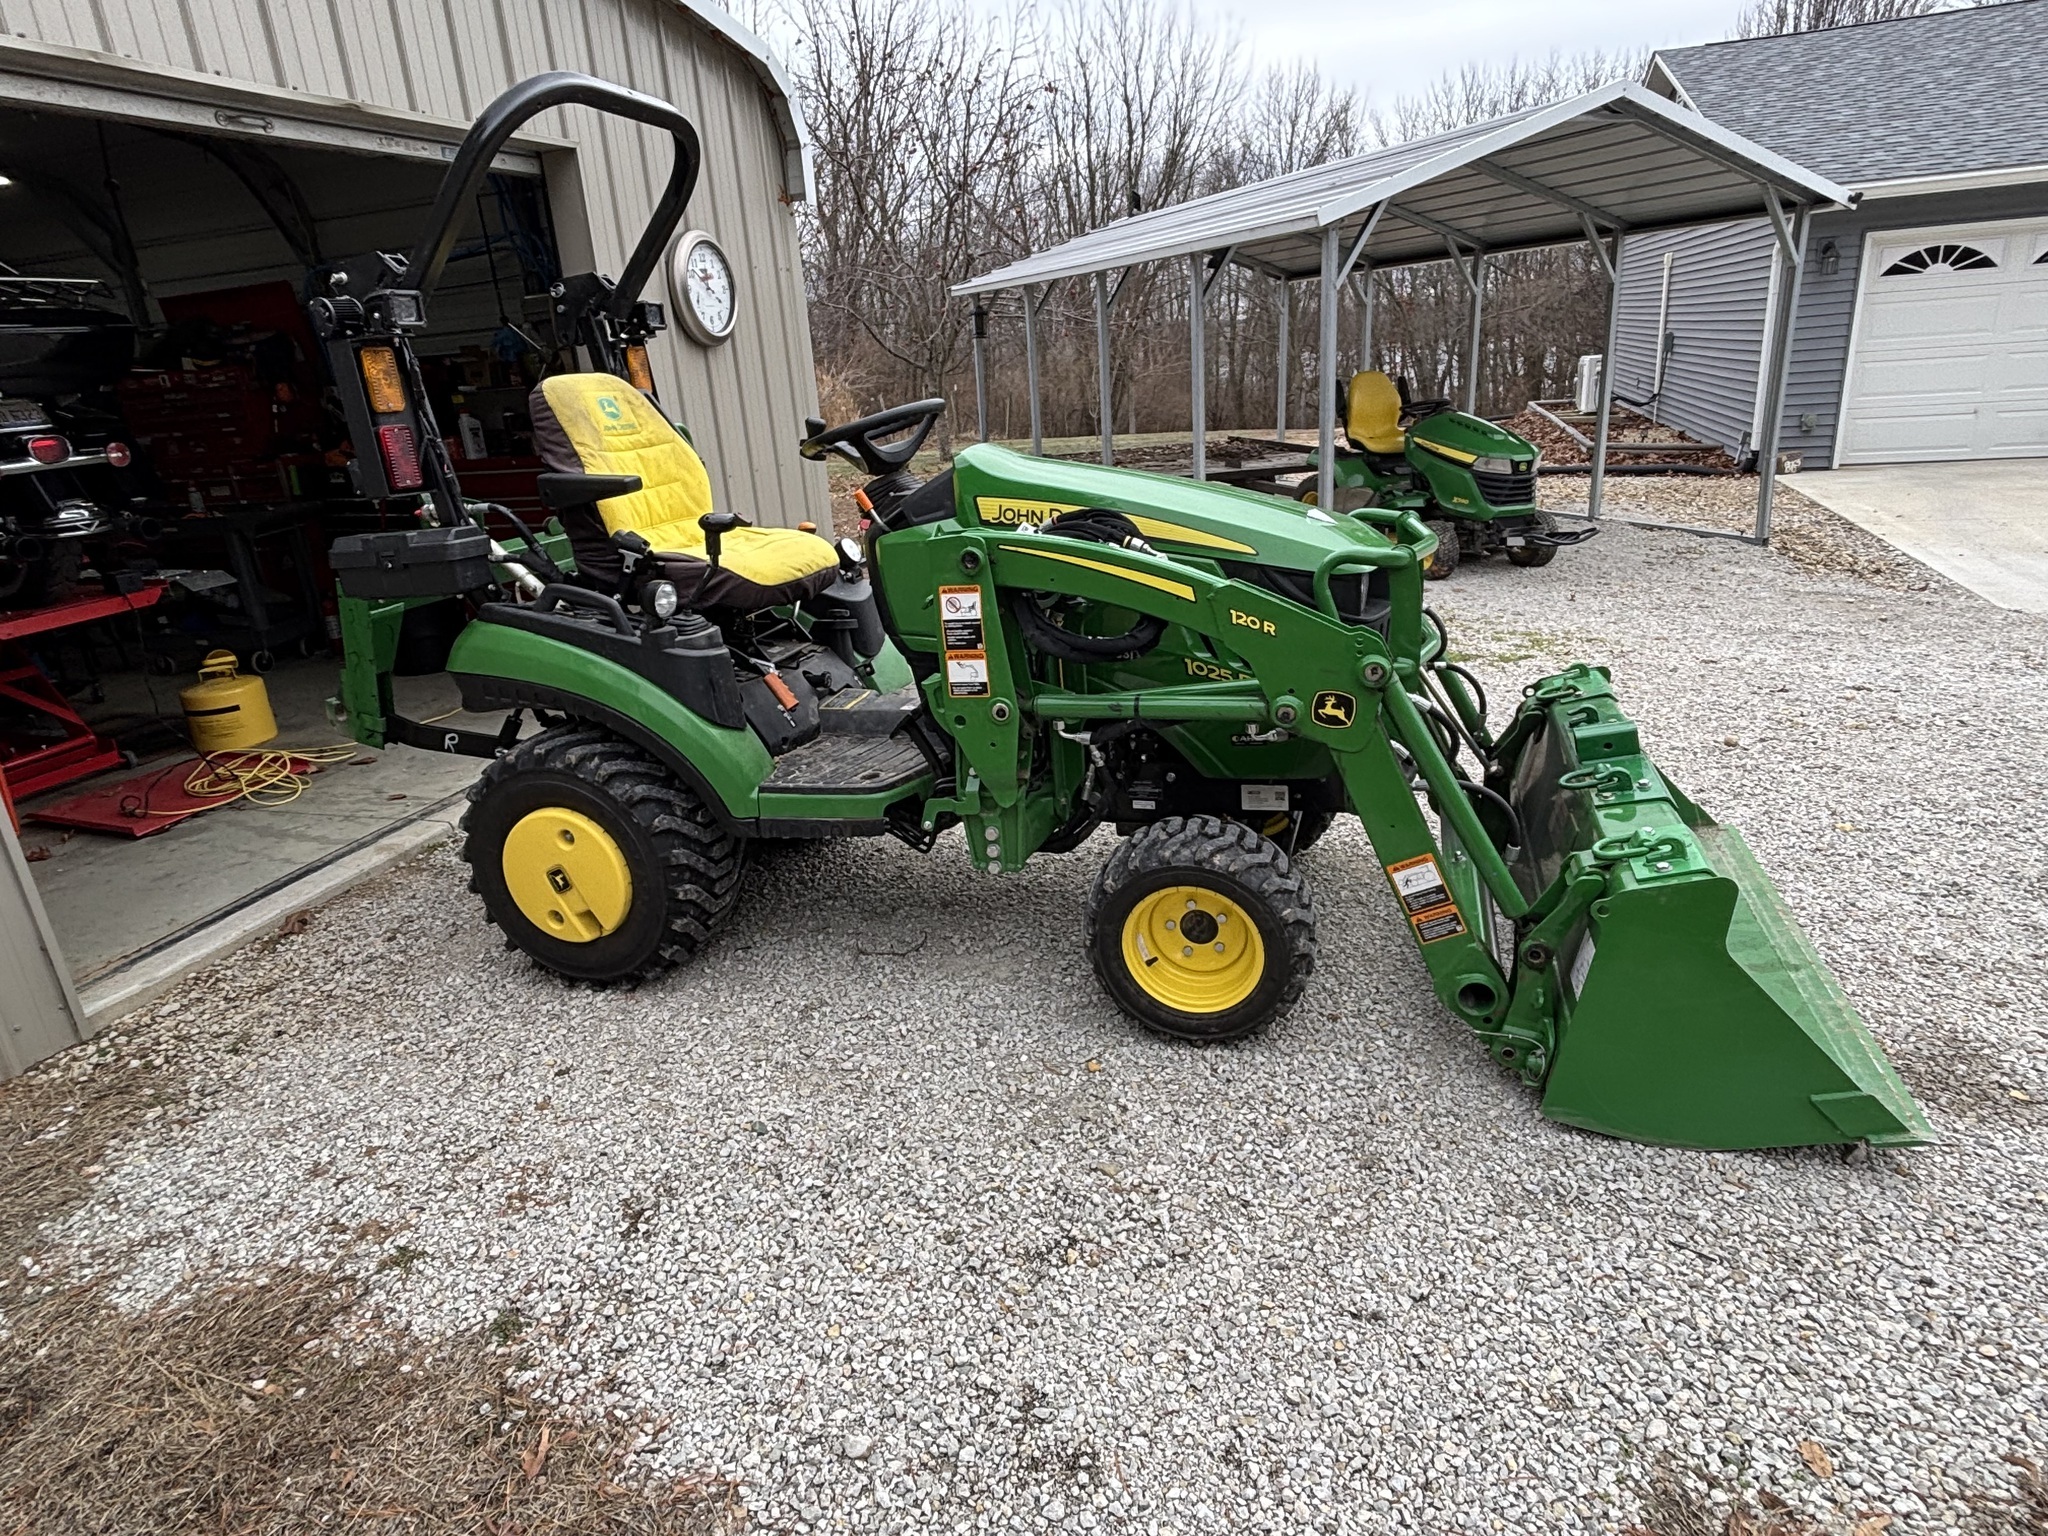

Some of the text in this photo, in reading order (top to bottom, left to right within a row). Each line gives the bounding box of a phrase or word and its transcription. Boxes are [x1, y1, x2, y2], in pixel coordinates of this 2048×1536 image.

[698, 253, 706, 262] 12
[691, 258, 698, 268] 11
[710, 259, 715, 269] 1
[991, 504, 1044, 524] JOHN
[444, 732, 459, 754] R
